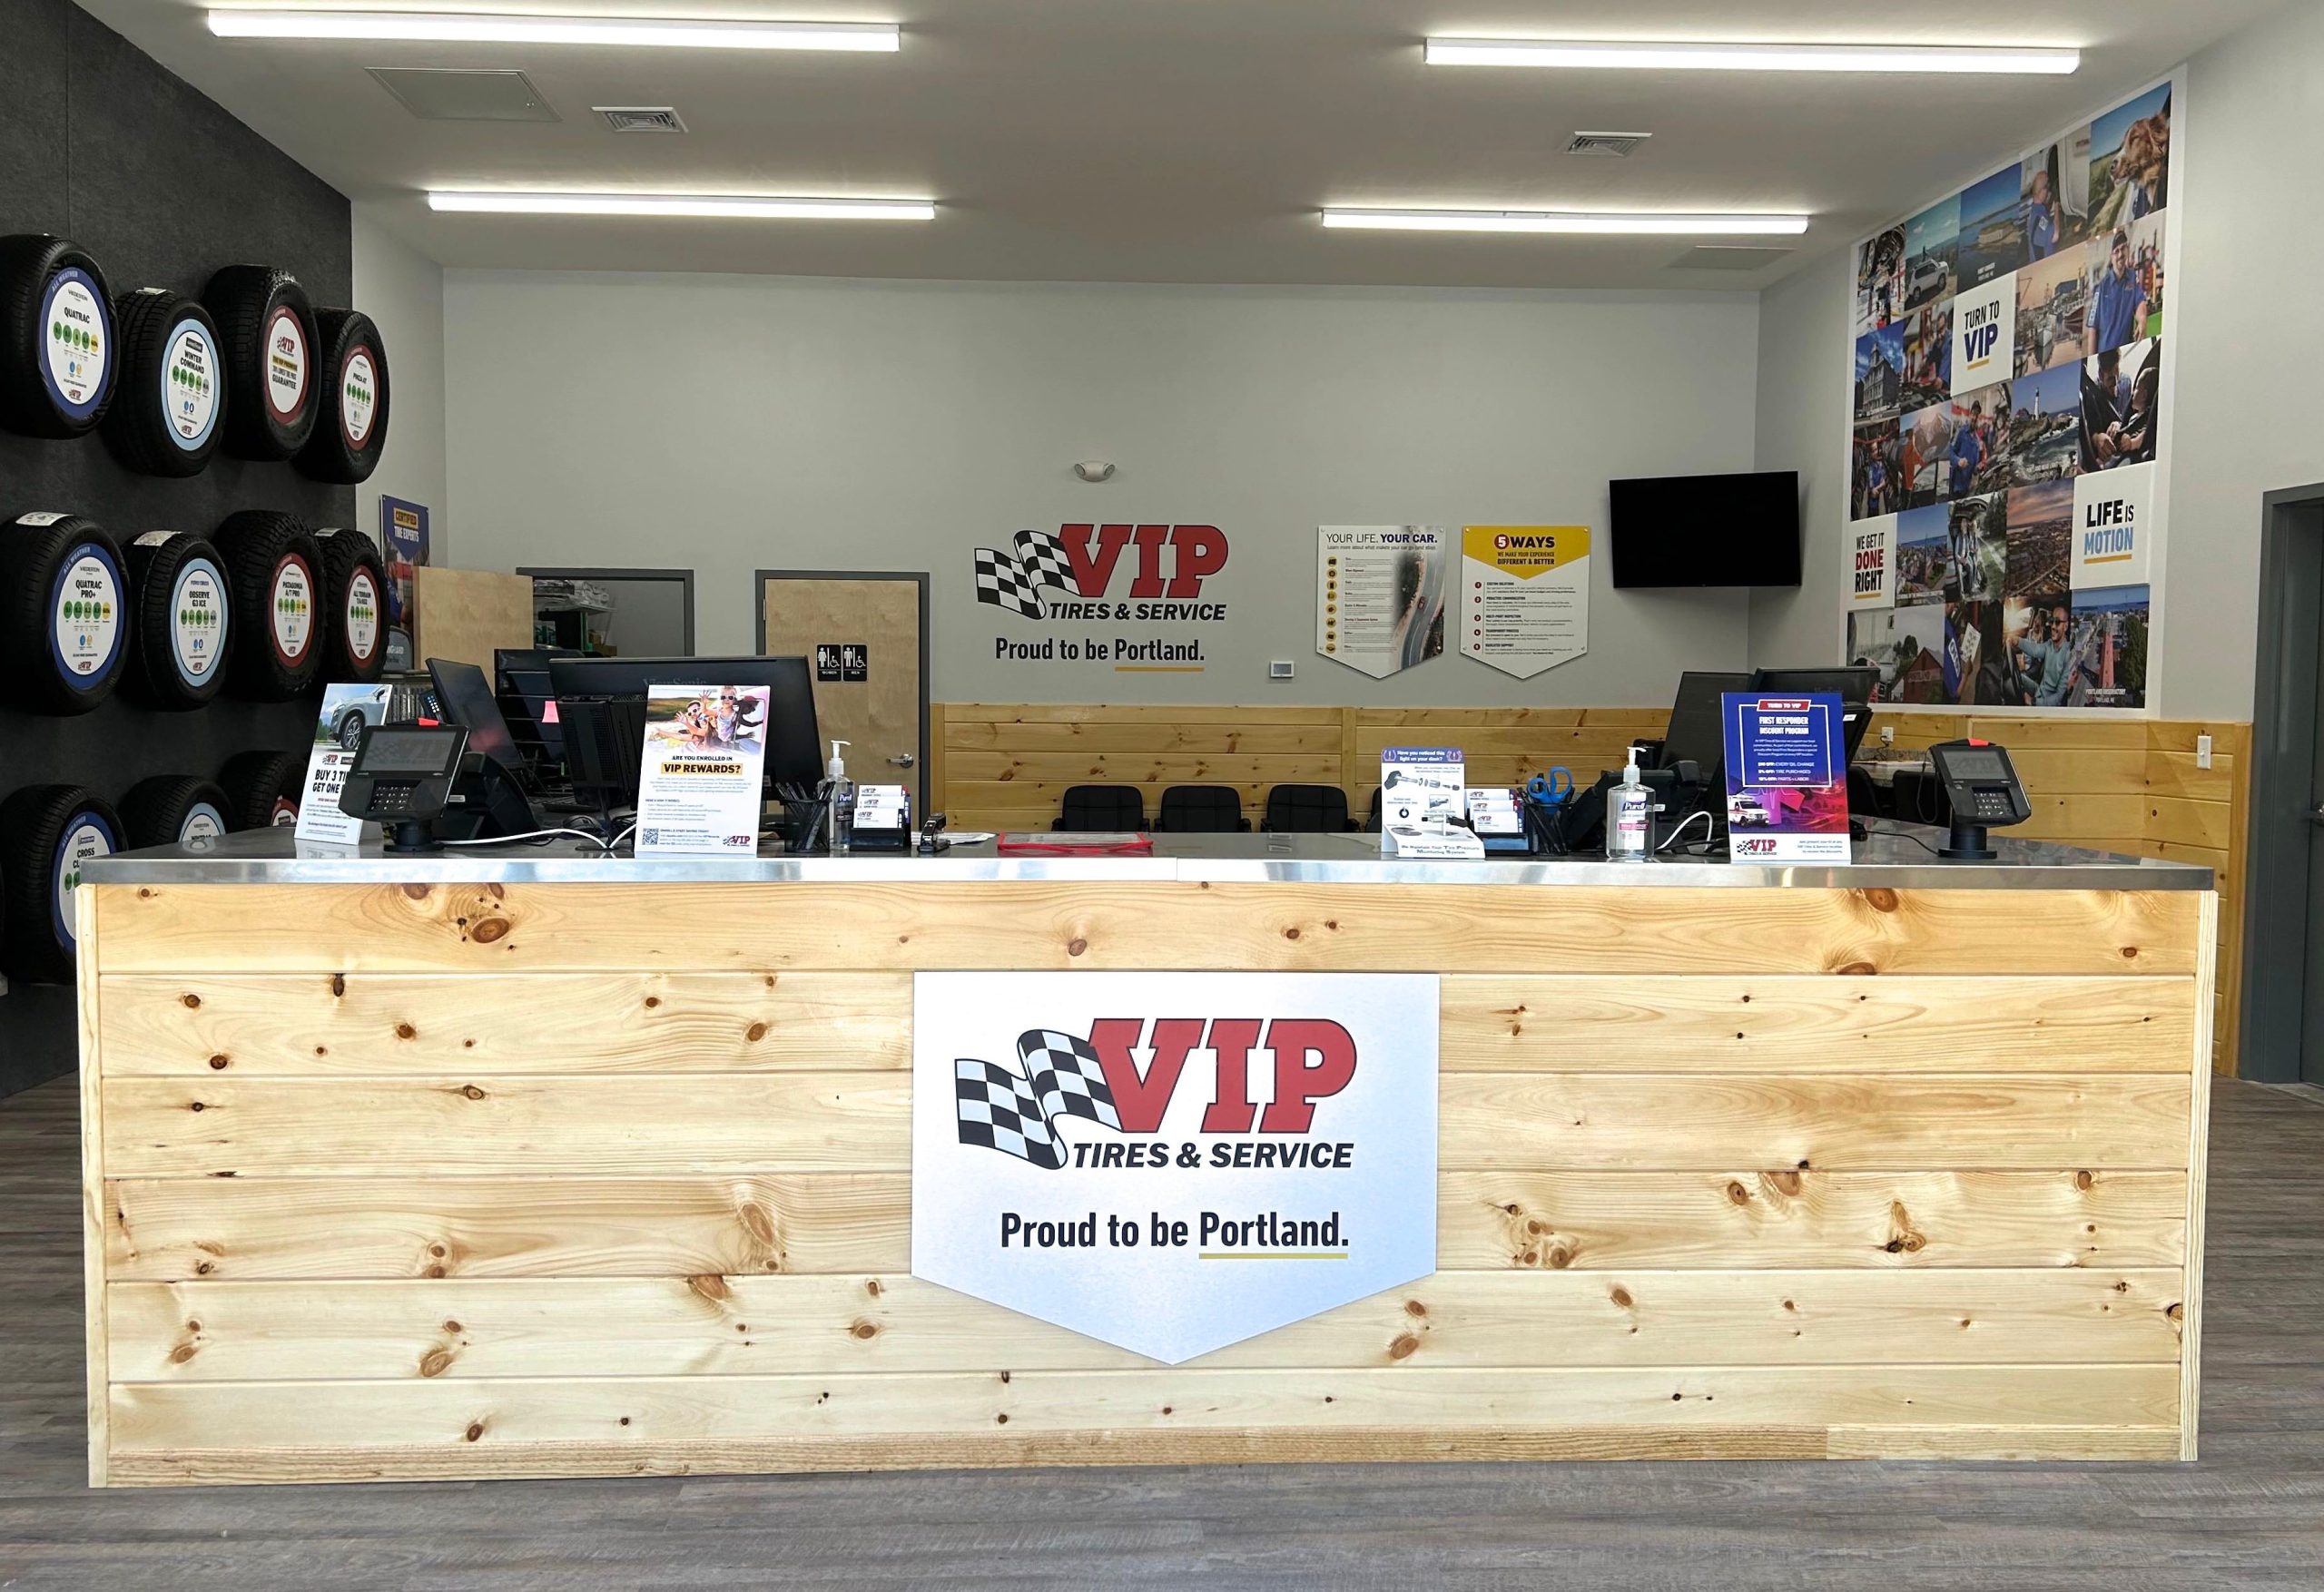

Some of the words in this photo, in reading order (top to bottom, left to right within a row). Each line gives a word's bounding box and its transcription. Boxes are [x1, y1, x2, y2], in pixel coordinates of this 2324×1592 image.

[64, 307, 90, 324] QUATRAC
[1965, 304, 1987, 330] TURN
[1989, 300, 2000, 320] TO
[1964, 323, 1998, 362] VIP
[184, 349, 202, 363] WINTER
[180, 357, 205, 374] COMMAND
[272, 374, 297, 390] GUARANTEE
[395, 510, 418, 526] CERTIFIED
[2086, 499, 2123, 528] LIFE
[2125, 505, 2134, 523] IS
[403, 527, 419, 543] EXPERTS
[1326, 534, 1353, 543] YOUR
[1356, 534, 1378, 543] LIFE.
[1381, 534, 1410, 543] YOUR
[1413, 534, 1438, 544] CAR.
[1498, 536, 1506, 547] 5
[1511, 536, 1555, 548] WAYS
[1856, 536, 1866, 551] WE
[1866, 534, 1877, 549] GET
[1878, 533, 1885, 547] IT
[2084, 526, 2133, 555] MOTION
[70, 546, 91, 564] WEATHER
[1059, 524, 1228, 598] VIP
[1856, 548, 1884, 571] DONE
[75, 579, 103, 590] QUATRAC
[1855, 569, 1884, 593] RIGHT
[81, 590, 96, 599] PRO+
[189, 591, 210, 599] OBSERVE
[1049, 603, 1110, 620] TIRES
[1114, 603, 1131, 620] &
[1136, 604, 1226, 621] SERVICE
[996, 637, 1053, 660] Proud
[1059, 641, 1078, 660] to
[1085, 639, 1108, 660] be
[1115, 639, 1205, 661] Portland.
[1759, 716, 1775, 724] FIRST
[1776, 716, 1808, 724] RESPONDER
[315, 769, 330, 781] BUY
[331, 771, 337, 781] 3
[664, 763, 682, 772] VIP
[683, 764, 742, 773] REWARDS?
[312, 782, 325, 792] GET
[326, 783, 340, 794] ONE
[732, 836, 751, 844] VIP
[1750, 840, 1777, 851] VIP
[76, 847, 95, 858] CROSS
[1088, 1018, 1357, 1133] VIP
[1073, 1142, 1169, 1168] TIRES
[1176, 1142, 1201, 1168] &
[1209, 1142, 1354, 1168] SERVICE
[1001, 1212, 1096, 1247] Proud
[1108, 1214, 1139, 1247] to
[1151, 1212, 1188, 1247] be
[1199, 1212, 1349, 1246] Portland.
